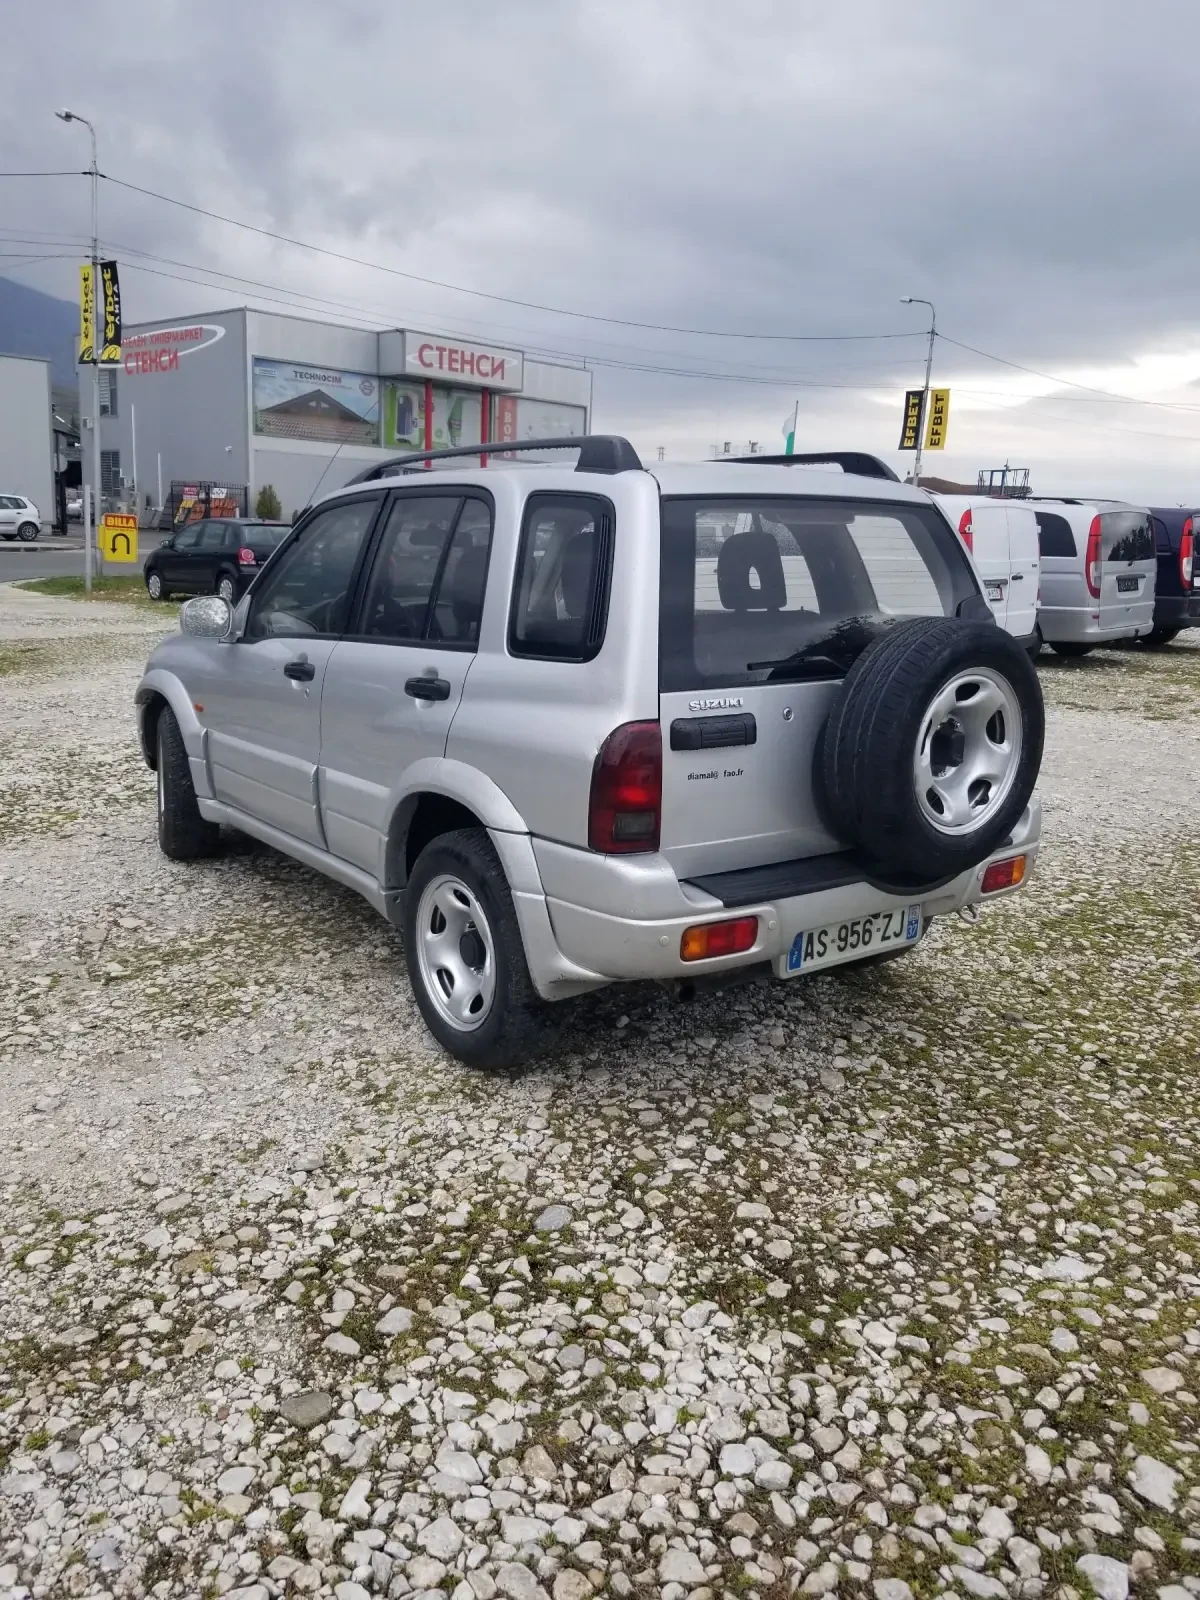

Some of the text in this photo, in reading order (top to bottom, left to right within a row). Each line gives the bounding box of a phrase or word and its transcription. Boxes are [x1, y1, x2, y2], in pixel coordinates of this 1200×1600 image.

[103, 268, 115, 340] efbet
[150, 327, 203, 345] ХИПЕРМАРКЕТ
[125, 348, 179, 375] СТЕНСИ
[418, 343, 505, 380] СТЕНСИ
[293, 370, 342, 384] TECHNOCIM
[903, 395, 919, 447] EFBET
[929, 394, 944, 446] EFBET
[106, 516, 136, 528] BILLA
[688, 697, 744, 712] SUZUKI
[723, 768, 744, 778] fao.fr
[907, 924, 918, 938] 37
